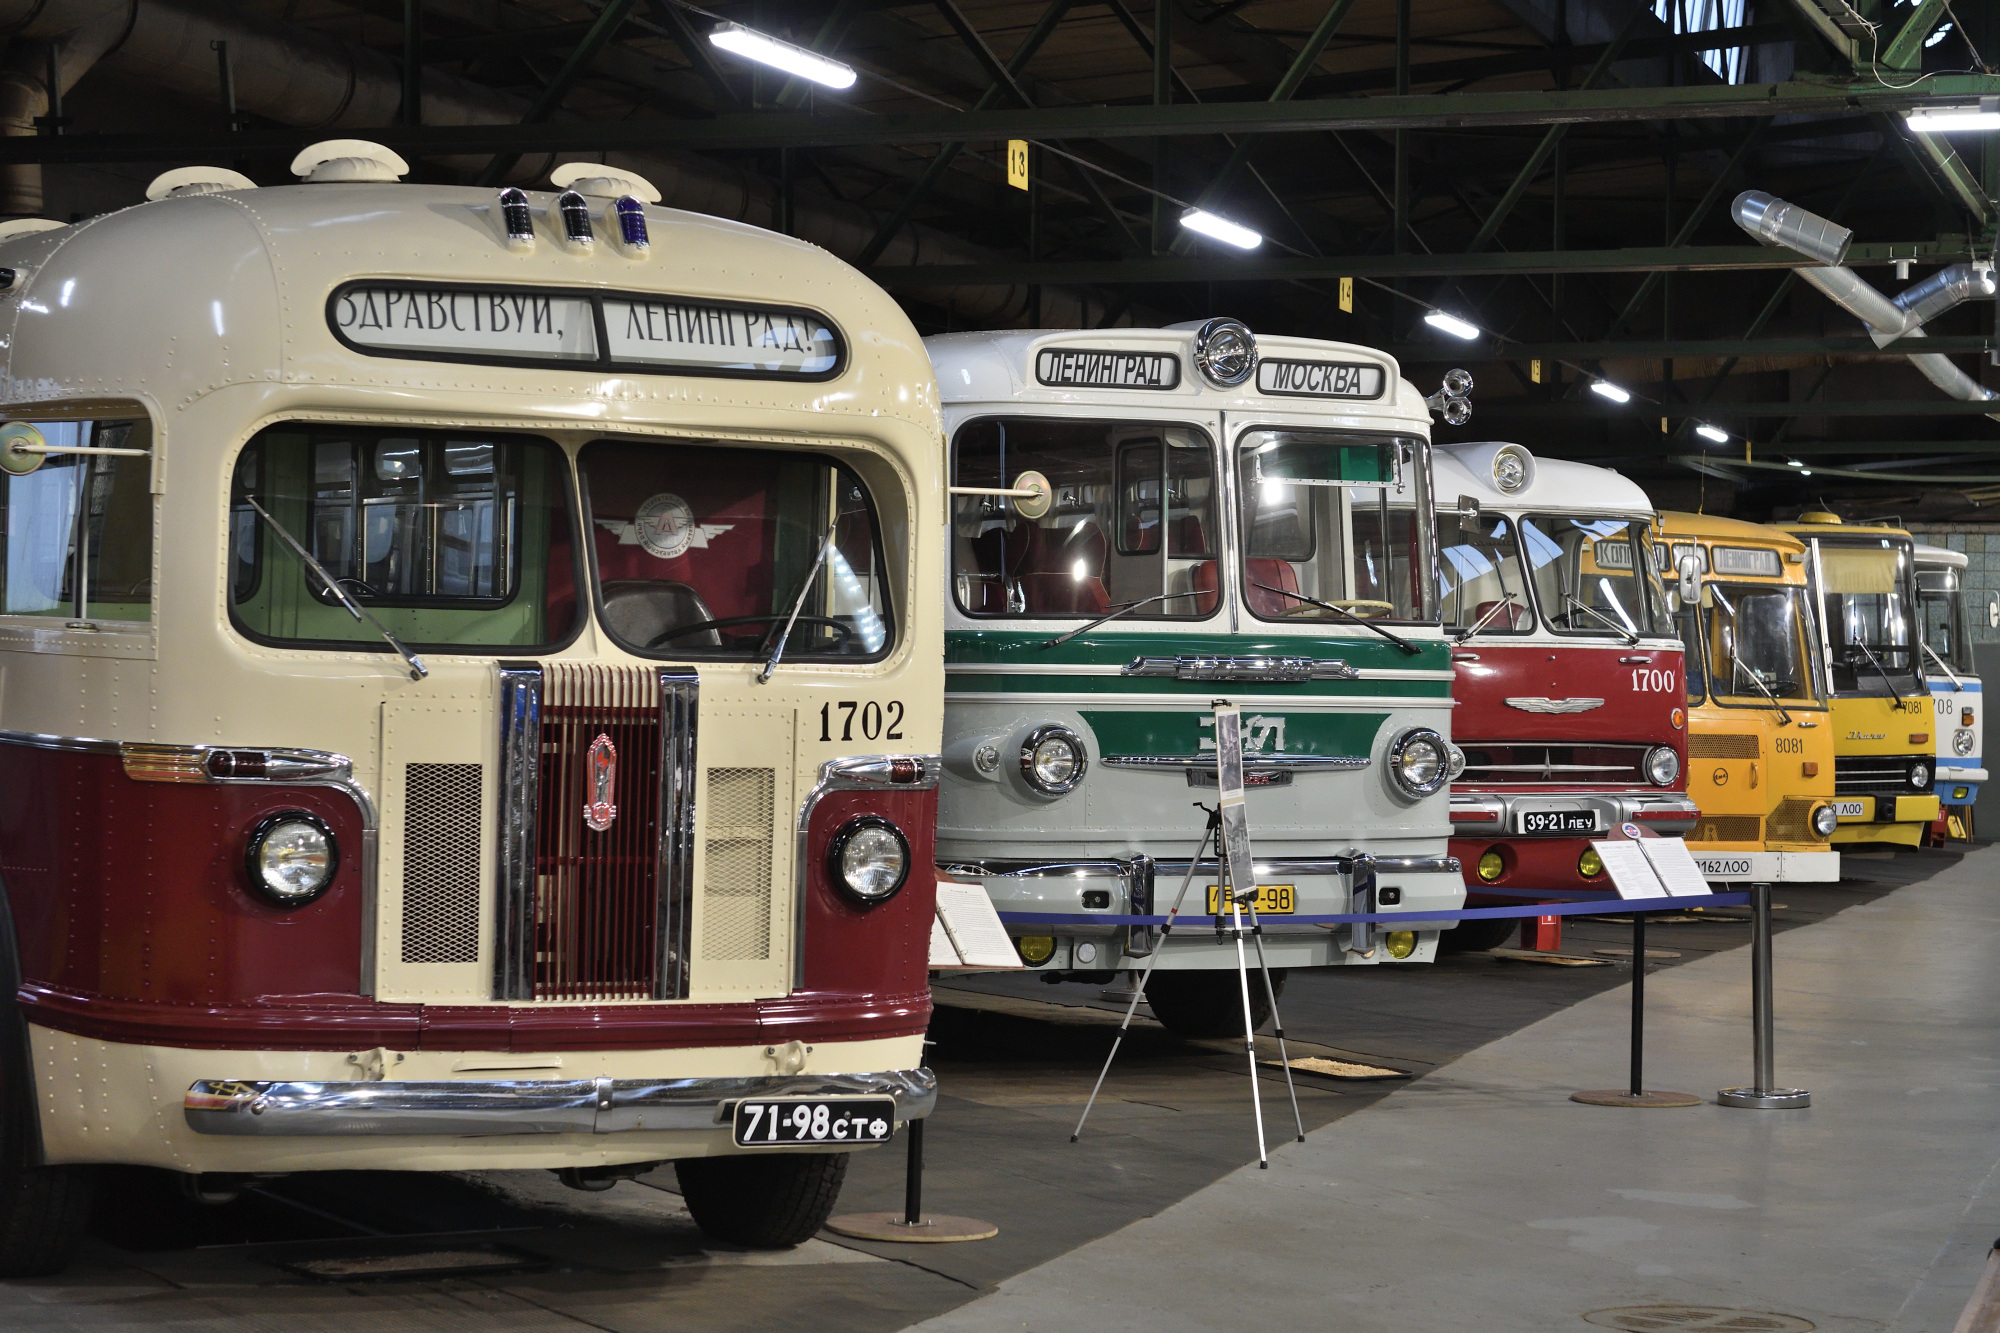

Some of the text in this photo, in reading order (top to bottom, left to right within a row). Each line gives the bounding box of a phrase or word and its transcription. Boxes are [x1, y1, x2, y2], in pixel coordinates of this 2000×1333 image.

[1012, 149, 1025, 177] 13
[1341, 282, 1351, 304] 14
[627, 302, 813, 353] ЛЕНИНГРАД!
[1046, 353, 1162, 386] ЛЕНИНГРАД
[1272, 363, 1361, 394] МОСКВА
[1632, 669, 1675, 693] 1700
[1933, 698, 1953, 715] 08
[819, 701, 904, 742] 1702
[1775, 737, 1804, 755] 8081
[1527, 813, 1565, 831] 39-21
